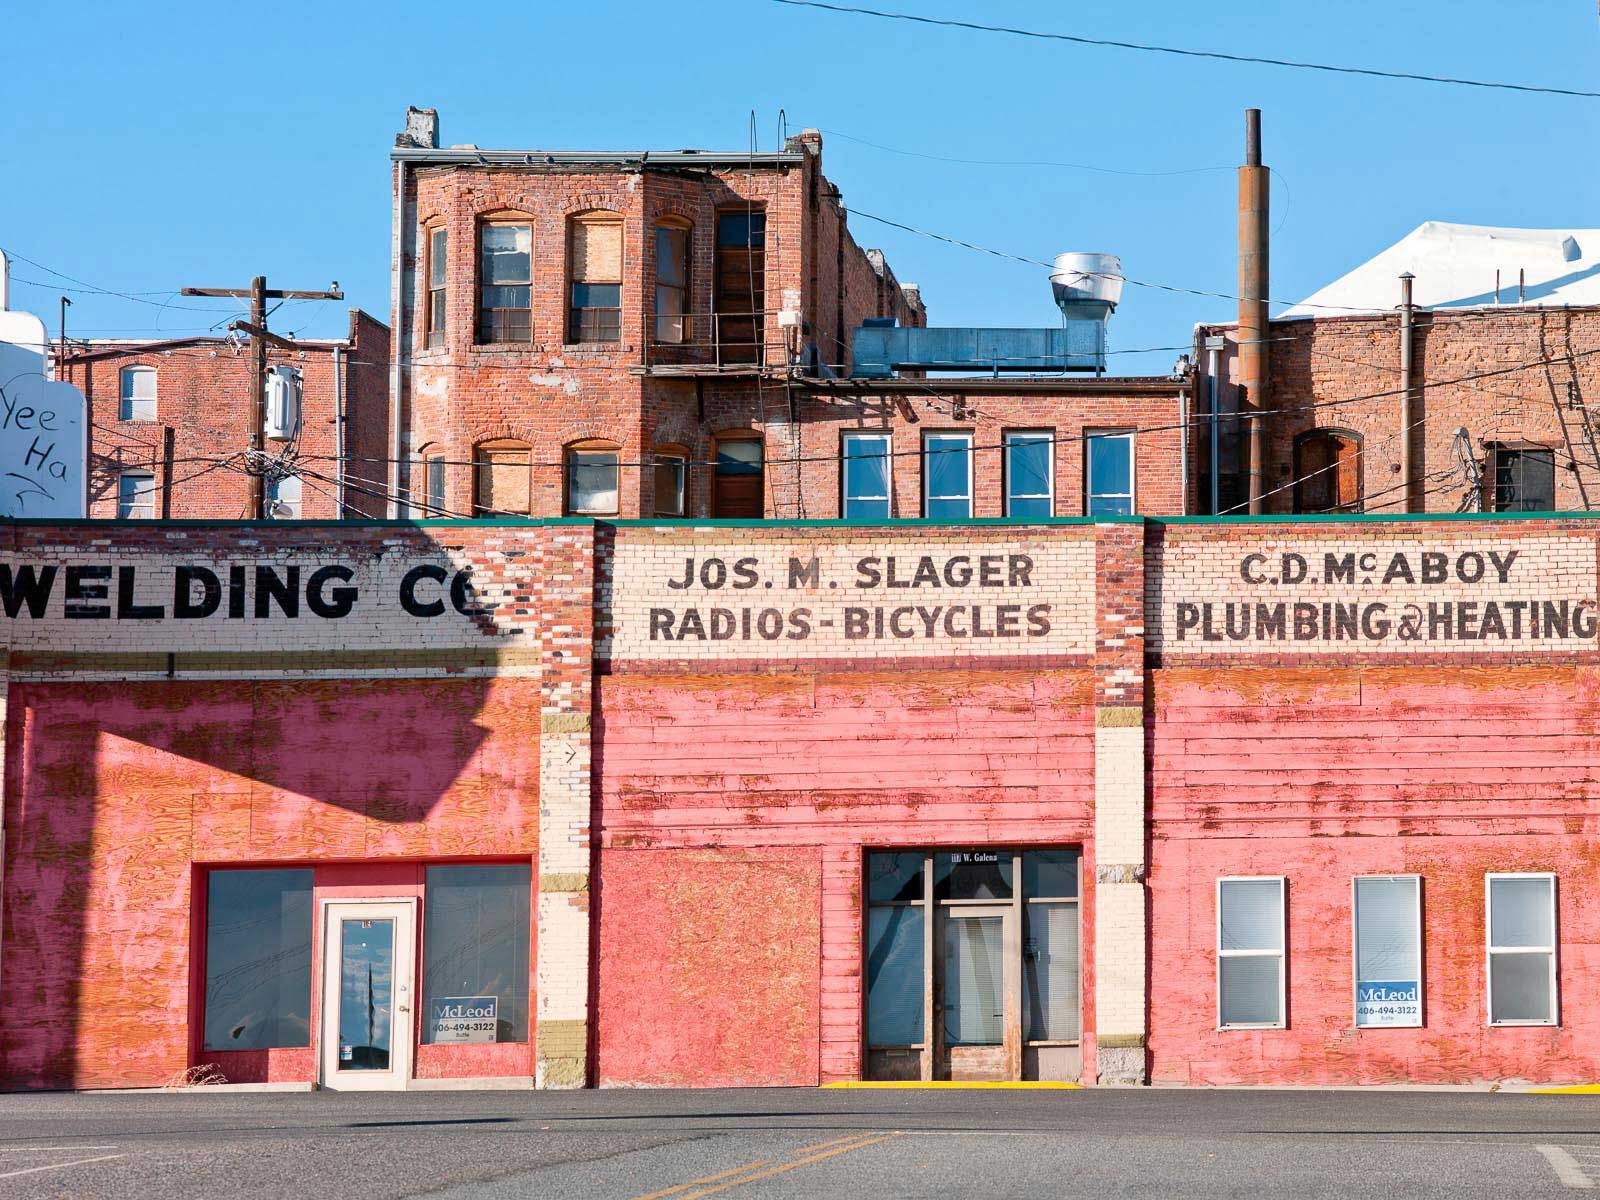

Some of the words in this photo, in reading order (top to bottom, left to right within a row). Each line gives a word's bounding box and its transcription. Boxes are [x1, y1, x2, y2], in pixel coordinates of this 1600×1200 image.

[24, 435, 67, 483] Ha
[667, 556, 772, 590] JOS.
[788, 556, 838, 590] M.
[856, 554, 1036, 589] SLAGER
[0, 564, 359, 619] WELDING
[974, 852, 998, 862] Galena
[1359, 987, 1417, 1001] McLeod
[434, 1003, 495, 1018] McLeod
[1359, 1006, 1417, 1015] 406-494-3122
[432, 1022, 495, 1032] 406-494-3122
